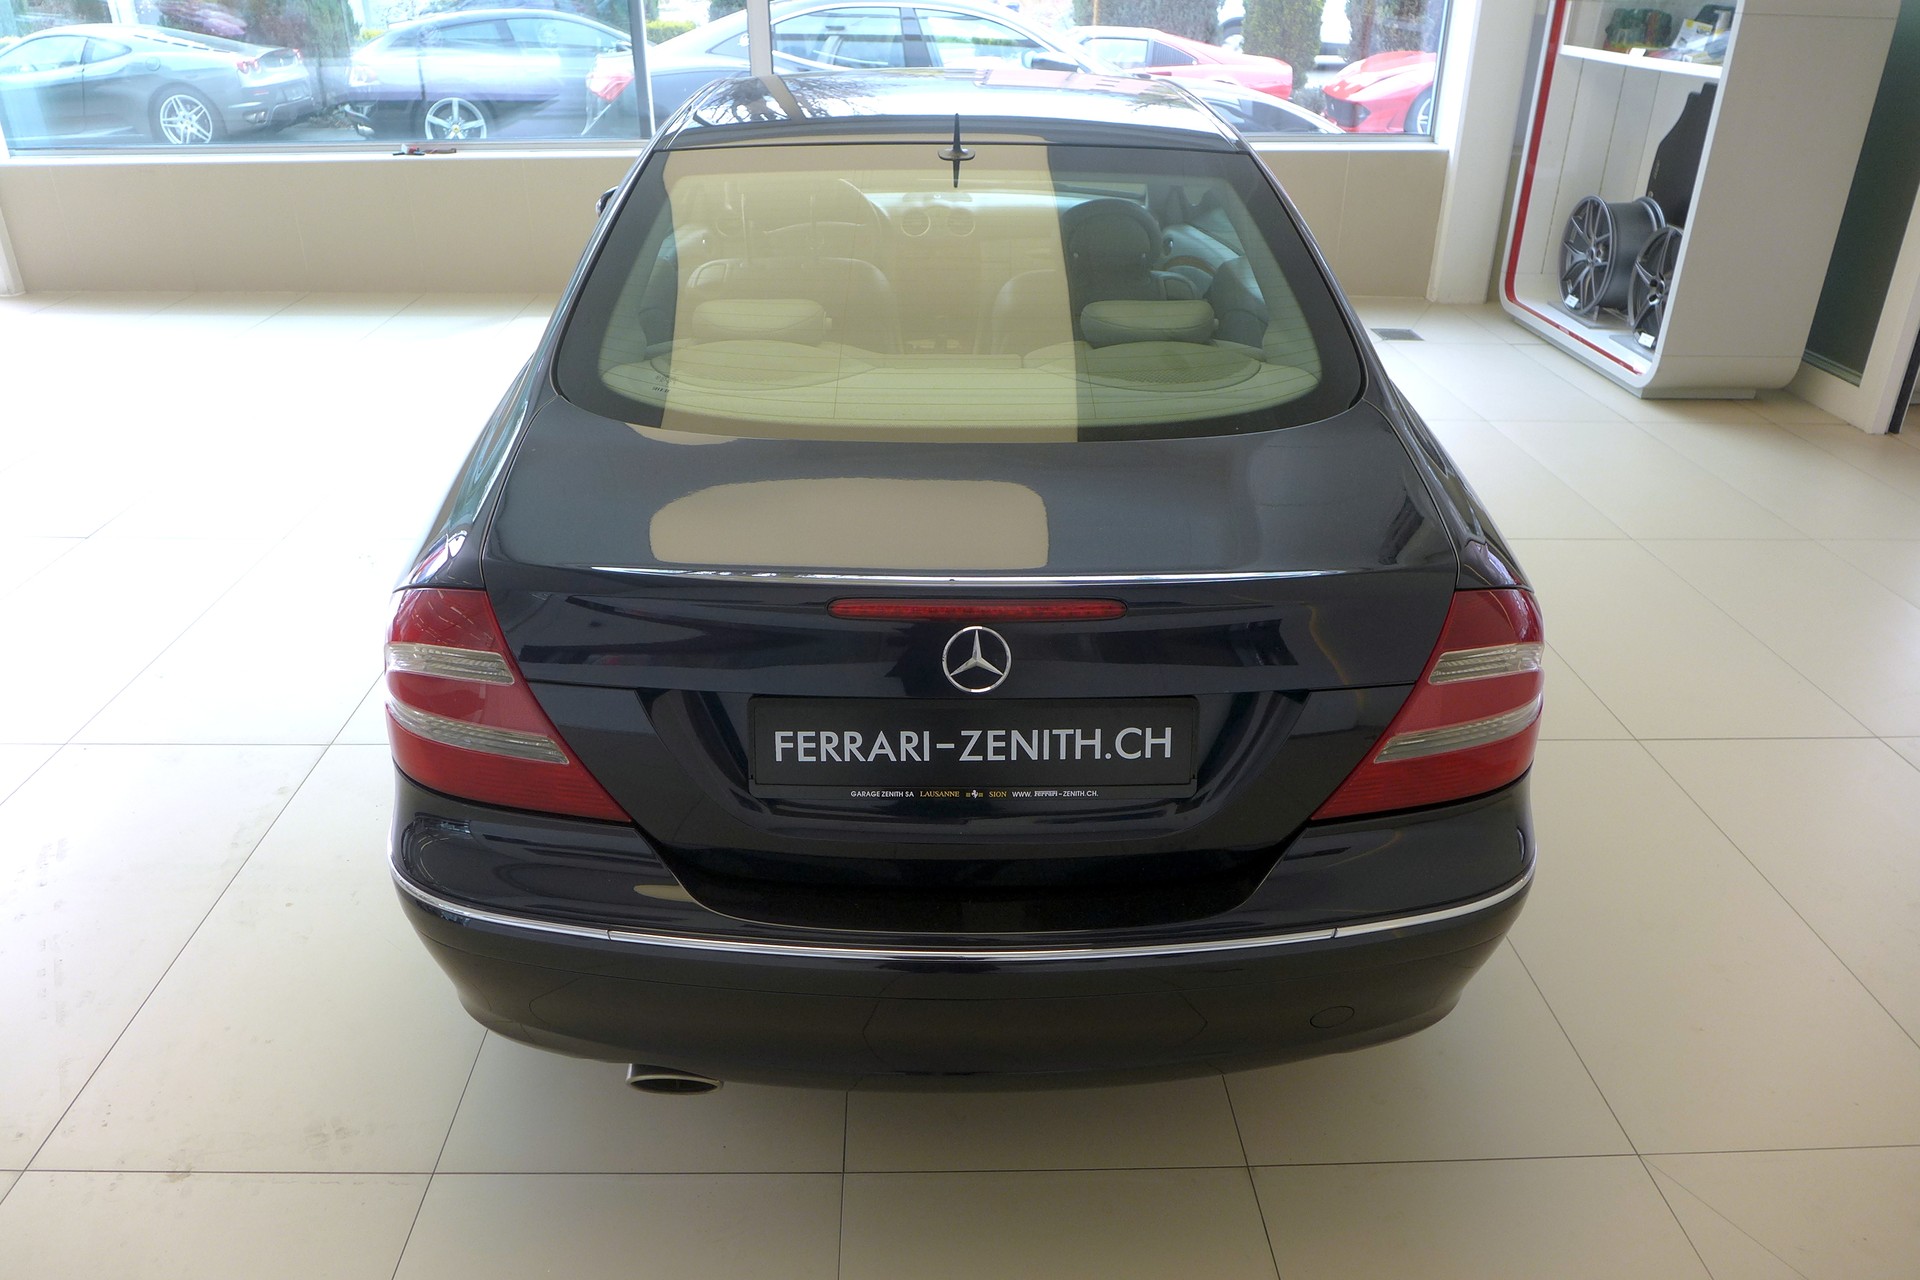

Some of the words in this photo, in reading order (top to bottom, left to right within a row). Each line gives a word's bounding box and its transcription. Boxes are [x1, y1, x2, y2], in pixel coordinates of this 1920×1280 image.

[774, 727, 1172, 763] FERRARI-ZENITH.CH
[850, 789, 880, 798] GARAGE
[881, 789, 904, 798] ZENITH
[905, 789, 915, 798] SA
[920, 789, 960, 798] LAUSANNE
[988, 789, 1008, 798] SION
